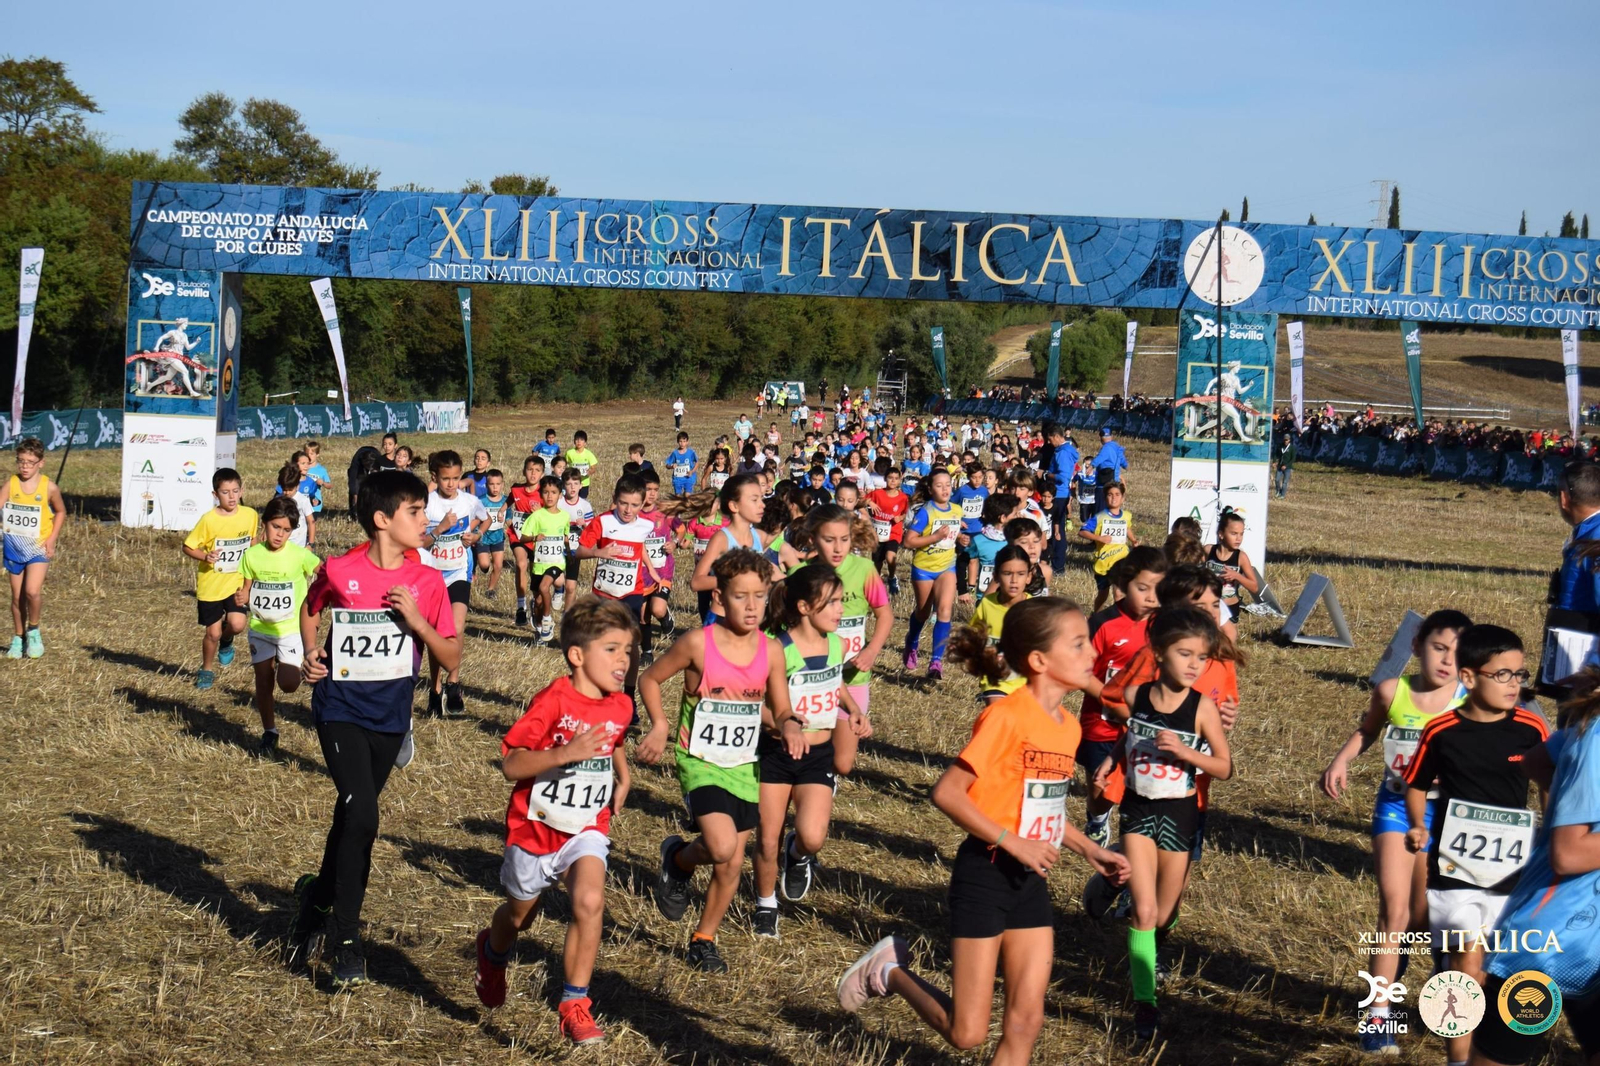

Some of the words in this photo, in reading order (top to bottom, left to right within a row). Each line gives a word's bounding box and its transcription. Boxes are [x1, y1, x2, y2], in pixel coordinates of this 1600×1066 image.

[147, 210, 252, 226] CAMPEONATO
[254, 214, 275, 227] DE
[277, 215, 369, 231] ANDALUCÍA
[181, 225, 202, 238] DE
[203, 226, 260, 240] CAMPO
[262, 227, 274, 241] A
[277, 226, 334, 243] TRAVÉS
[429, 206, 590, 263] XLIII
[594, 213, 720, 248] CROSS
[215, 240, 247, 254] POR
[248, 241, 303, 256] CLUBES
[776, 208, 1085, 287] ITÁLICA
[593, 247, 765, 270] INTERNACIONAL
[1312, 238, 1475, 300] XLIII
[428, 263, 575, 285] INTERNATIONAL
[583, 269, 641, 287] CROSS
[643, 270, 733, 289] COUNTRY
[176, 288, 210, 298] Sevilla
[1307, 295, 1468, 320] INTERNATIONAL
[1468, 303, 1526, 323] CROSS
[1229, 330, 1264, 341] Sevilla
[7, 514, 38, 528] 4309
[1104, 527, 1125, 537] 4281
[431, 545, 464, 561] 4419
[537, 545, 563, 556] 4319
[599, 568, 633, 587] 4328
[253, 595, 292, 610] 4249
[340, 633, 407, 658] 4247
[717, 703, 749, 714] ITÁLICA
[795, 687, 841, 715] 4538
[700, 723, 756, 748] 4187
[1130, 748, 1185, 782] 4539
[541, 780, 607, 809] 4114
[1472, 809, 1513, 824] ITÁLICA
[1449, 832, 1523, 865] 4214
